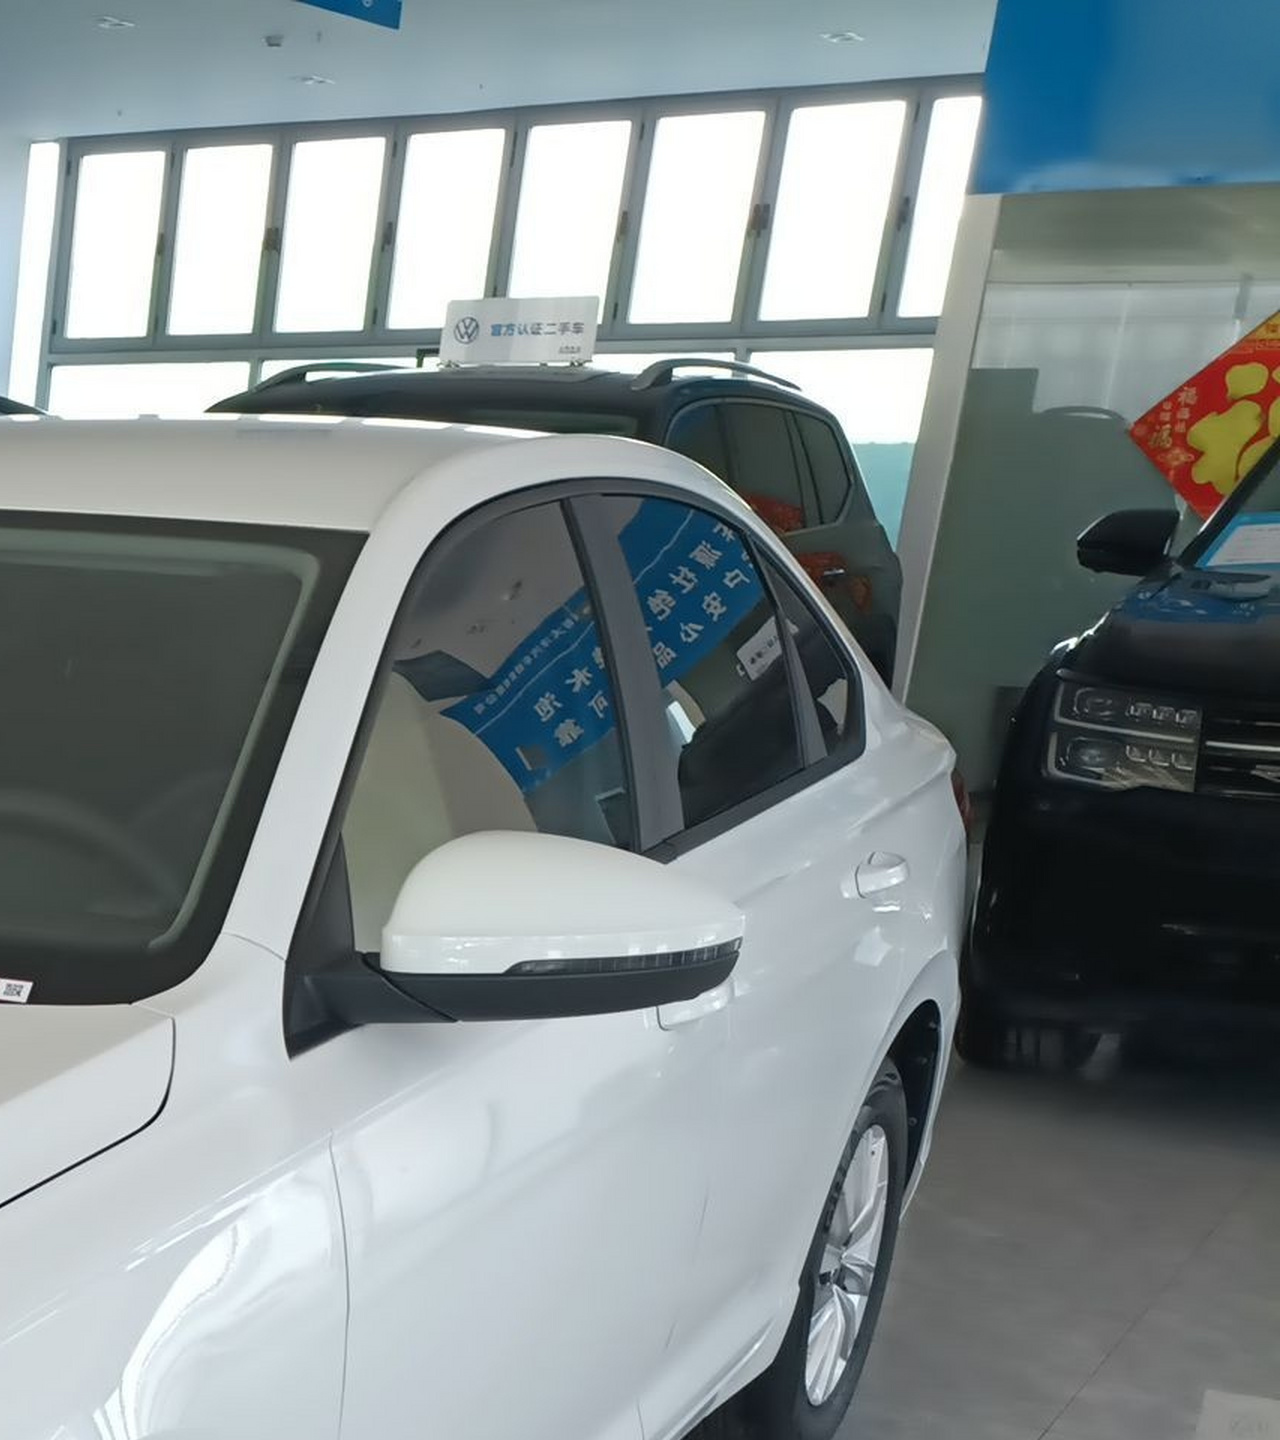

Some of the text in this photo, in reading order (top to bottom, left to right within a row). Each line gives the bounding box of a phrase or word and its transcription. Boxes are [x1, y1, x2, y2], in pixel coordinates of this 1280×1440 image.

[491, 322, 584, 336] 官方认证二手车
